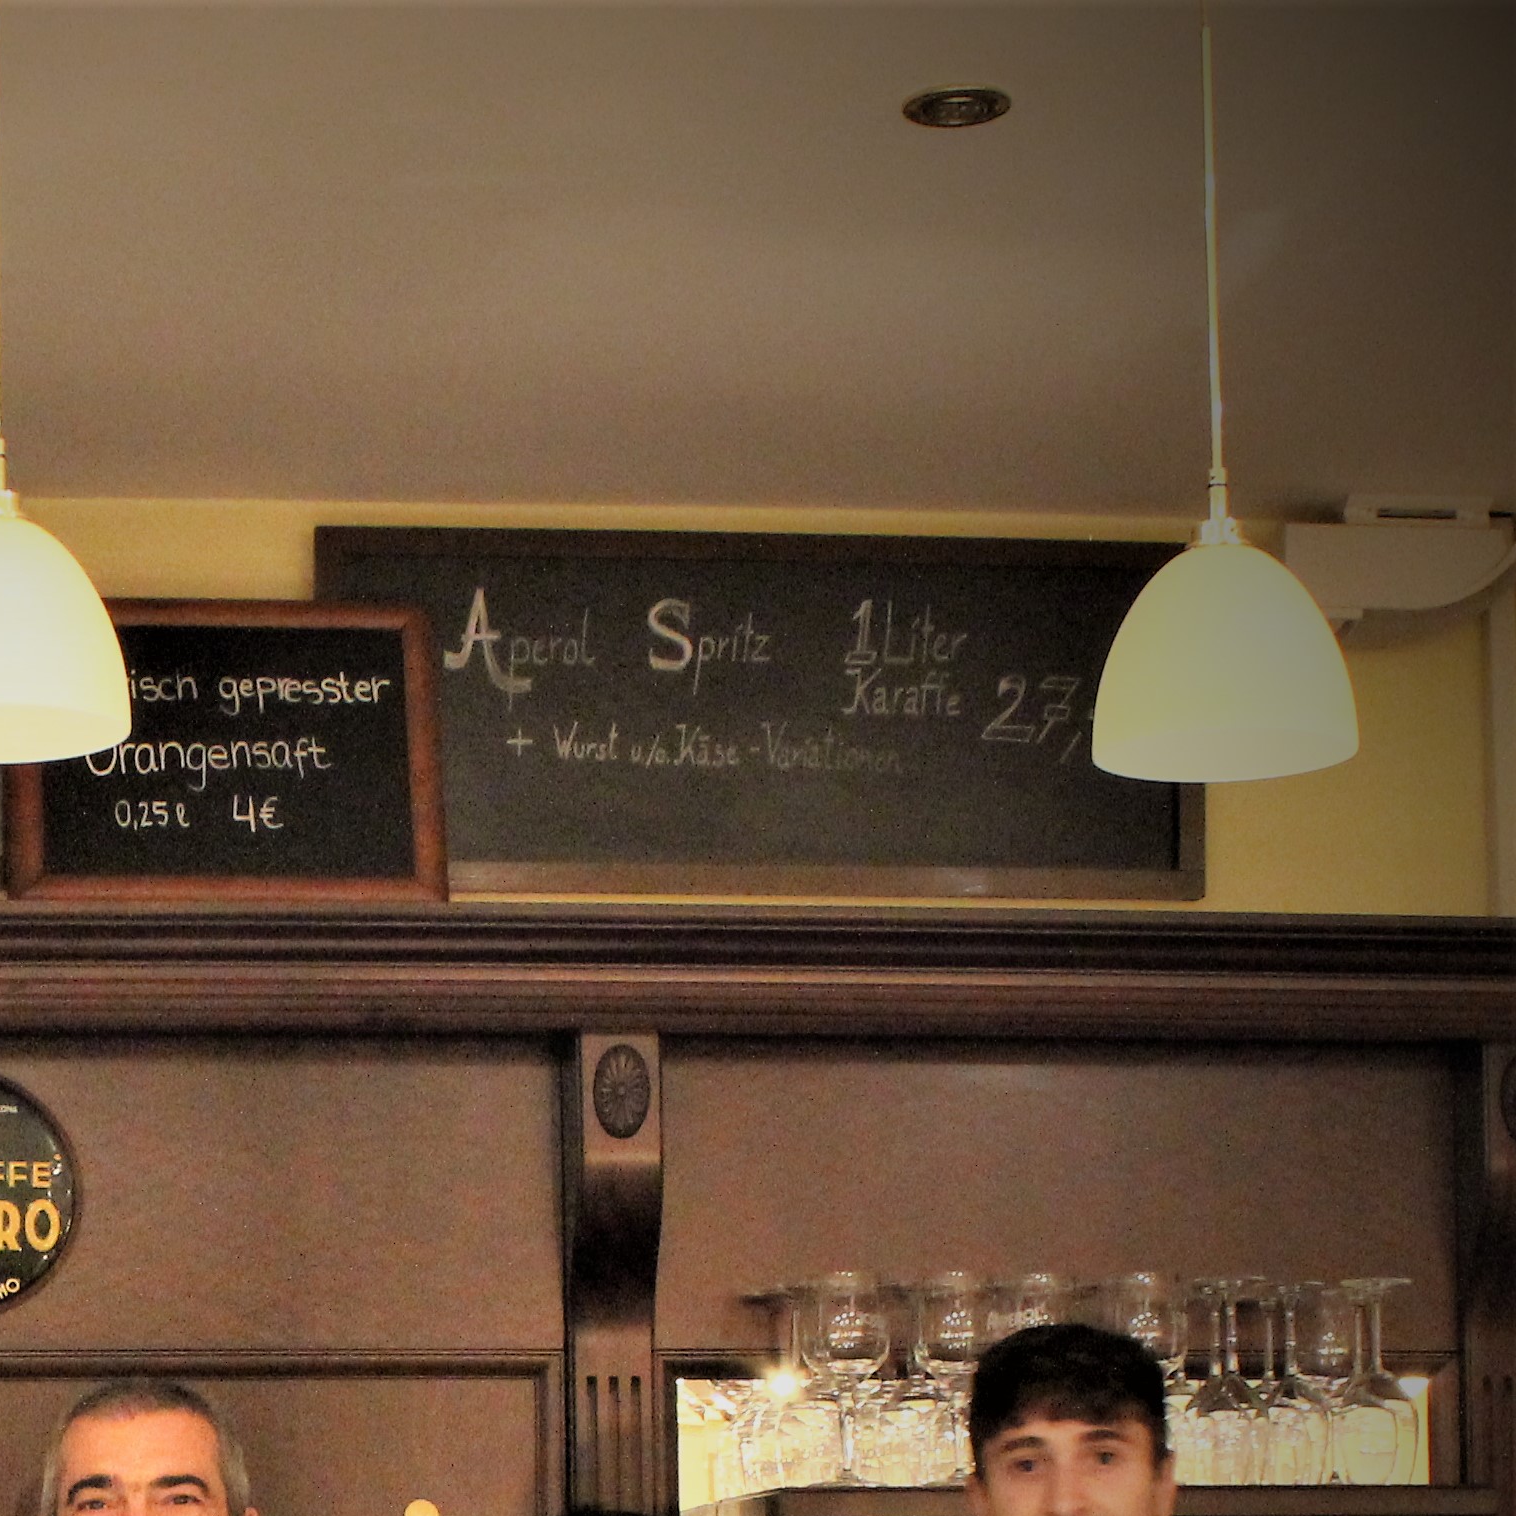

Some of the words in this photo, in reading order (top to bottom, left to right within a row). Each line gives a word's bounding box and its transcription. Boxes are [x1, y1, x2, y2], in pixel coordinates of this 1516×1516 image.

[443, 587, 595, 712] Aperol
[647, 598, 771, 695] Spritz
[129, 668, 199, 701] isch
[218, 670, 391, 716] gepresster
[841, 667, 962, 717] Karaffe
[84, 735, 332, 791] Orangensaft
[553, 720, 619, 761] Wurst
